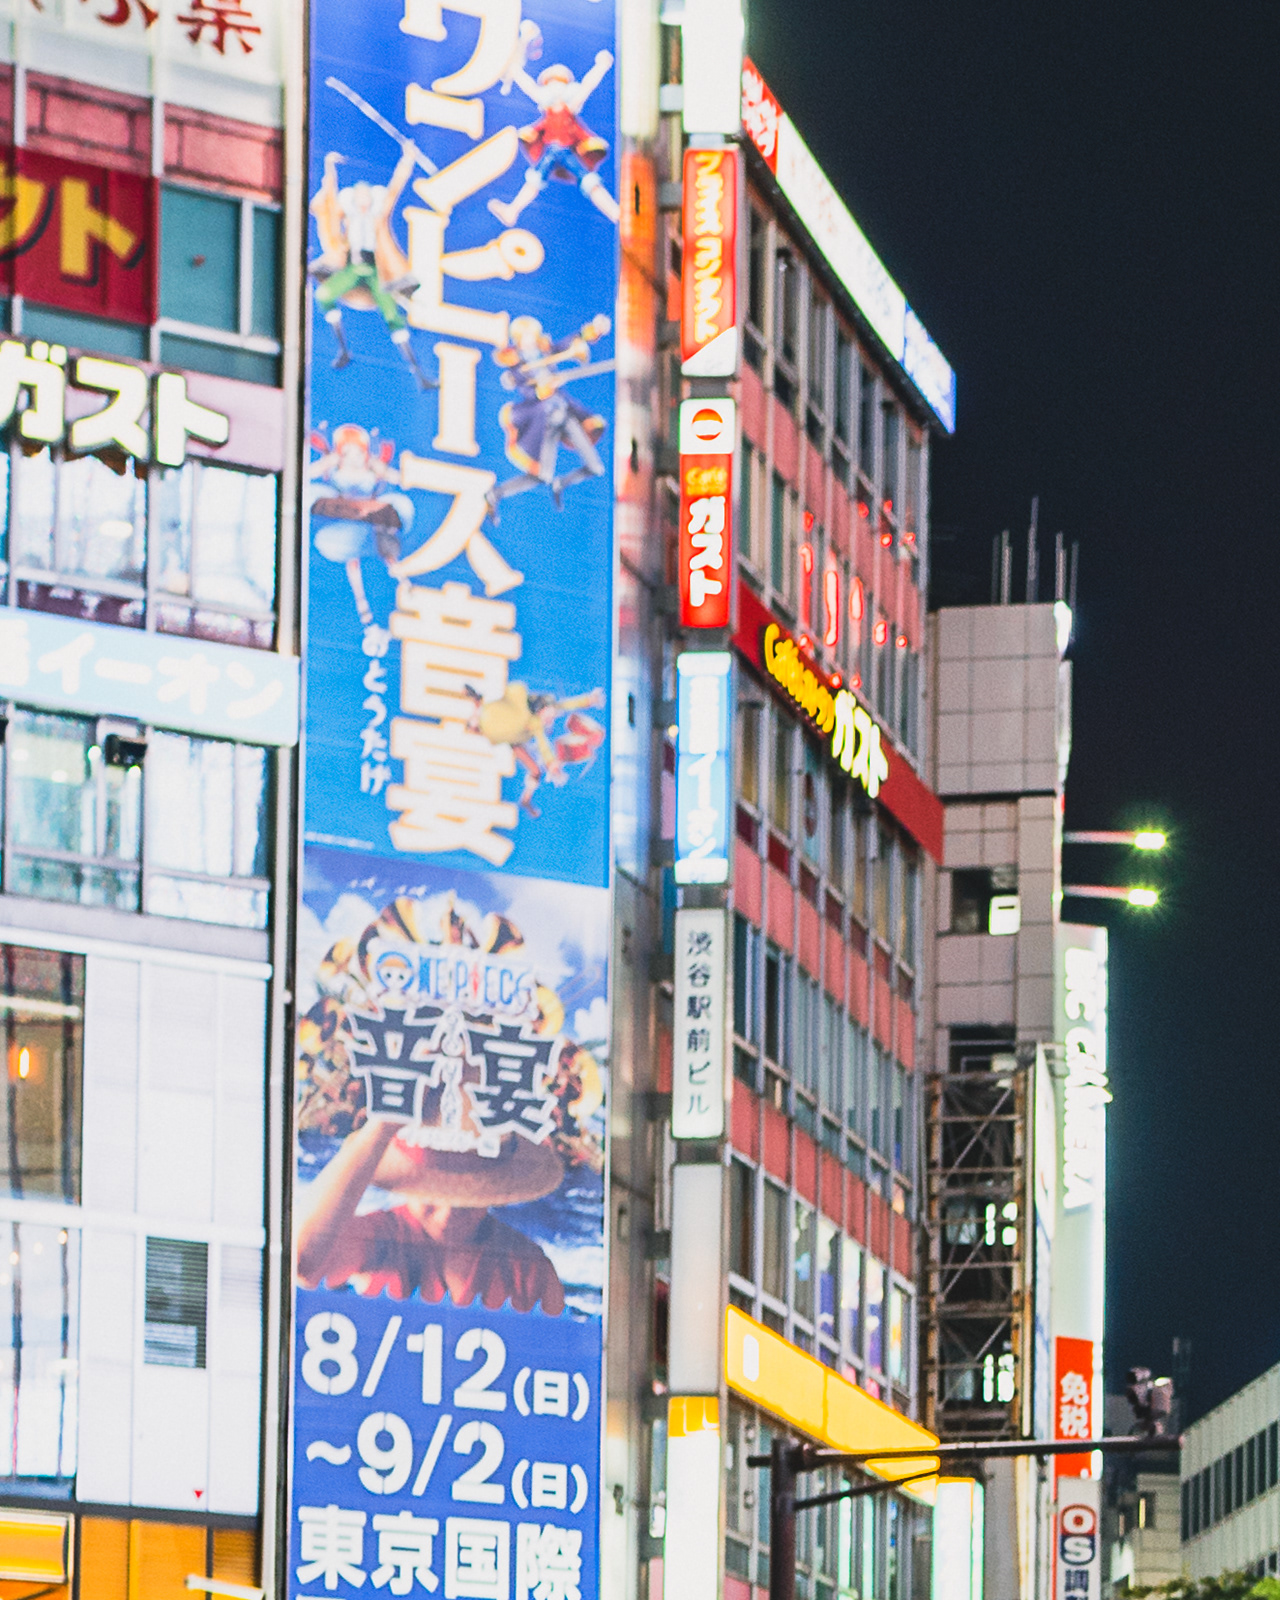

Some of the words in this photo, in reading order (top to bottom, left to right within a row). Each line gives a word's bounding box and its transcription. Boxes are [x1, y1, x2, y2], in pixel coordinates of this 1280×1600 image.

[0, 340, 229, 466] ガスト
[688, 497, 726, 607] ガスト
[1059, 1371, 1090, 1439] 免税
